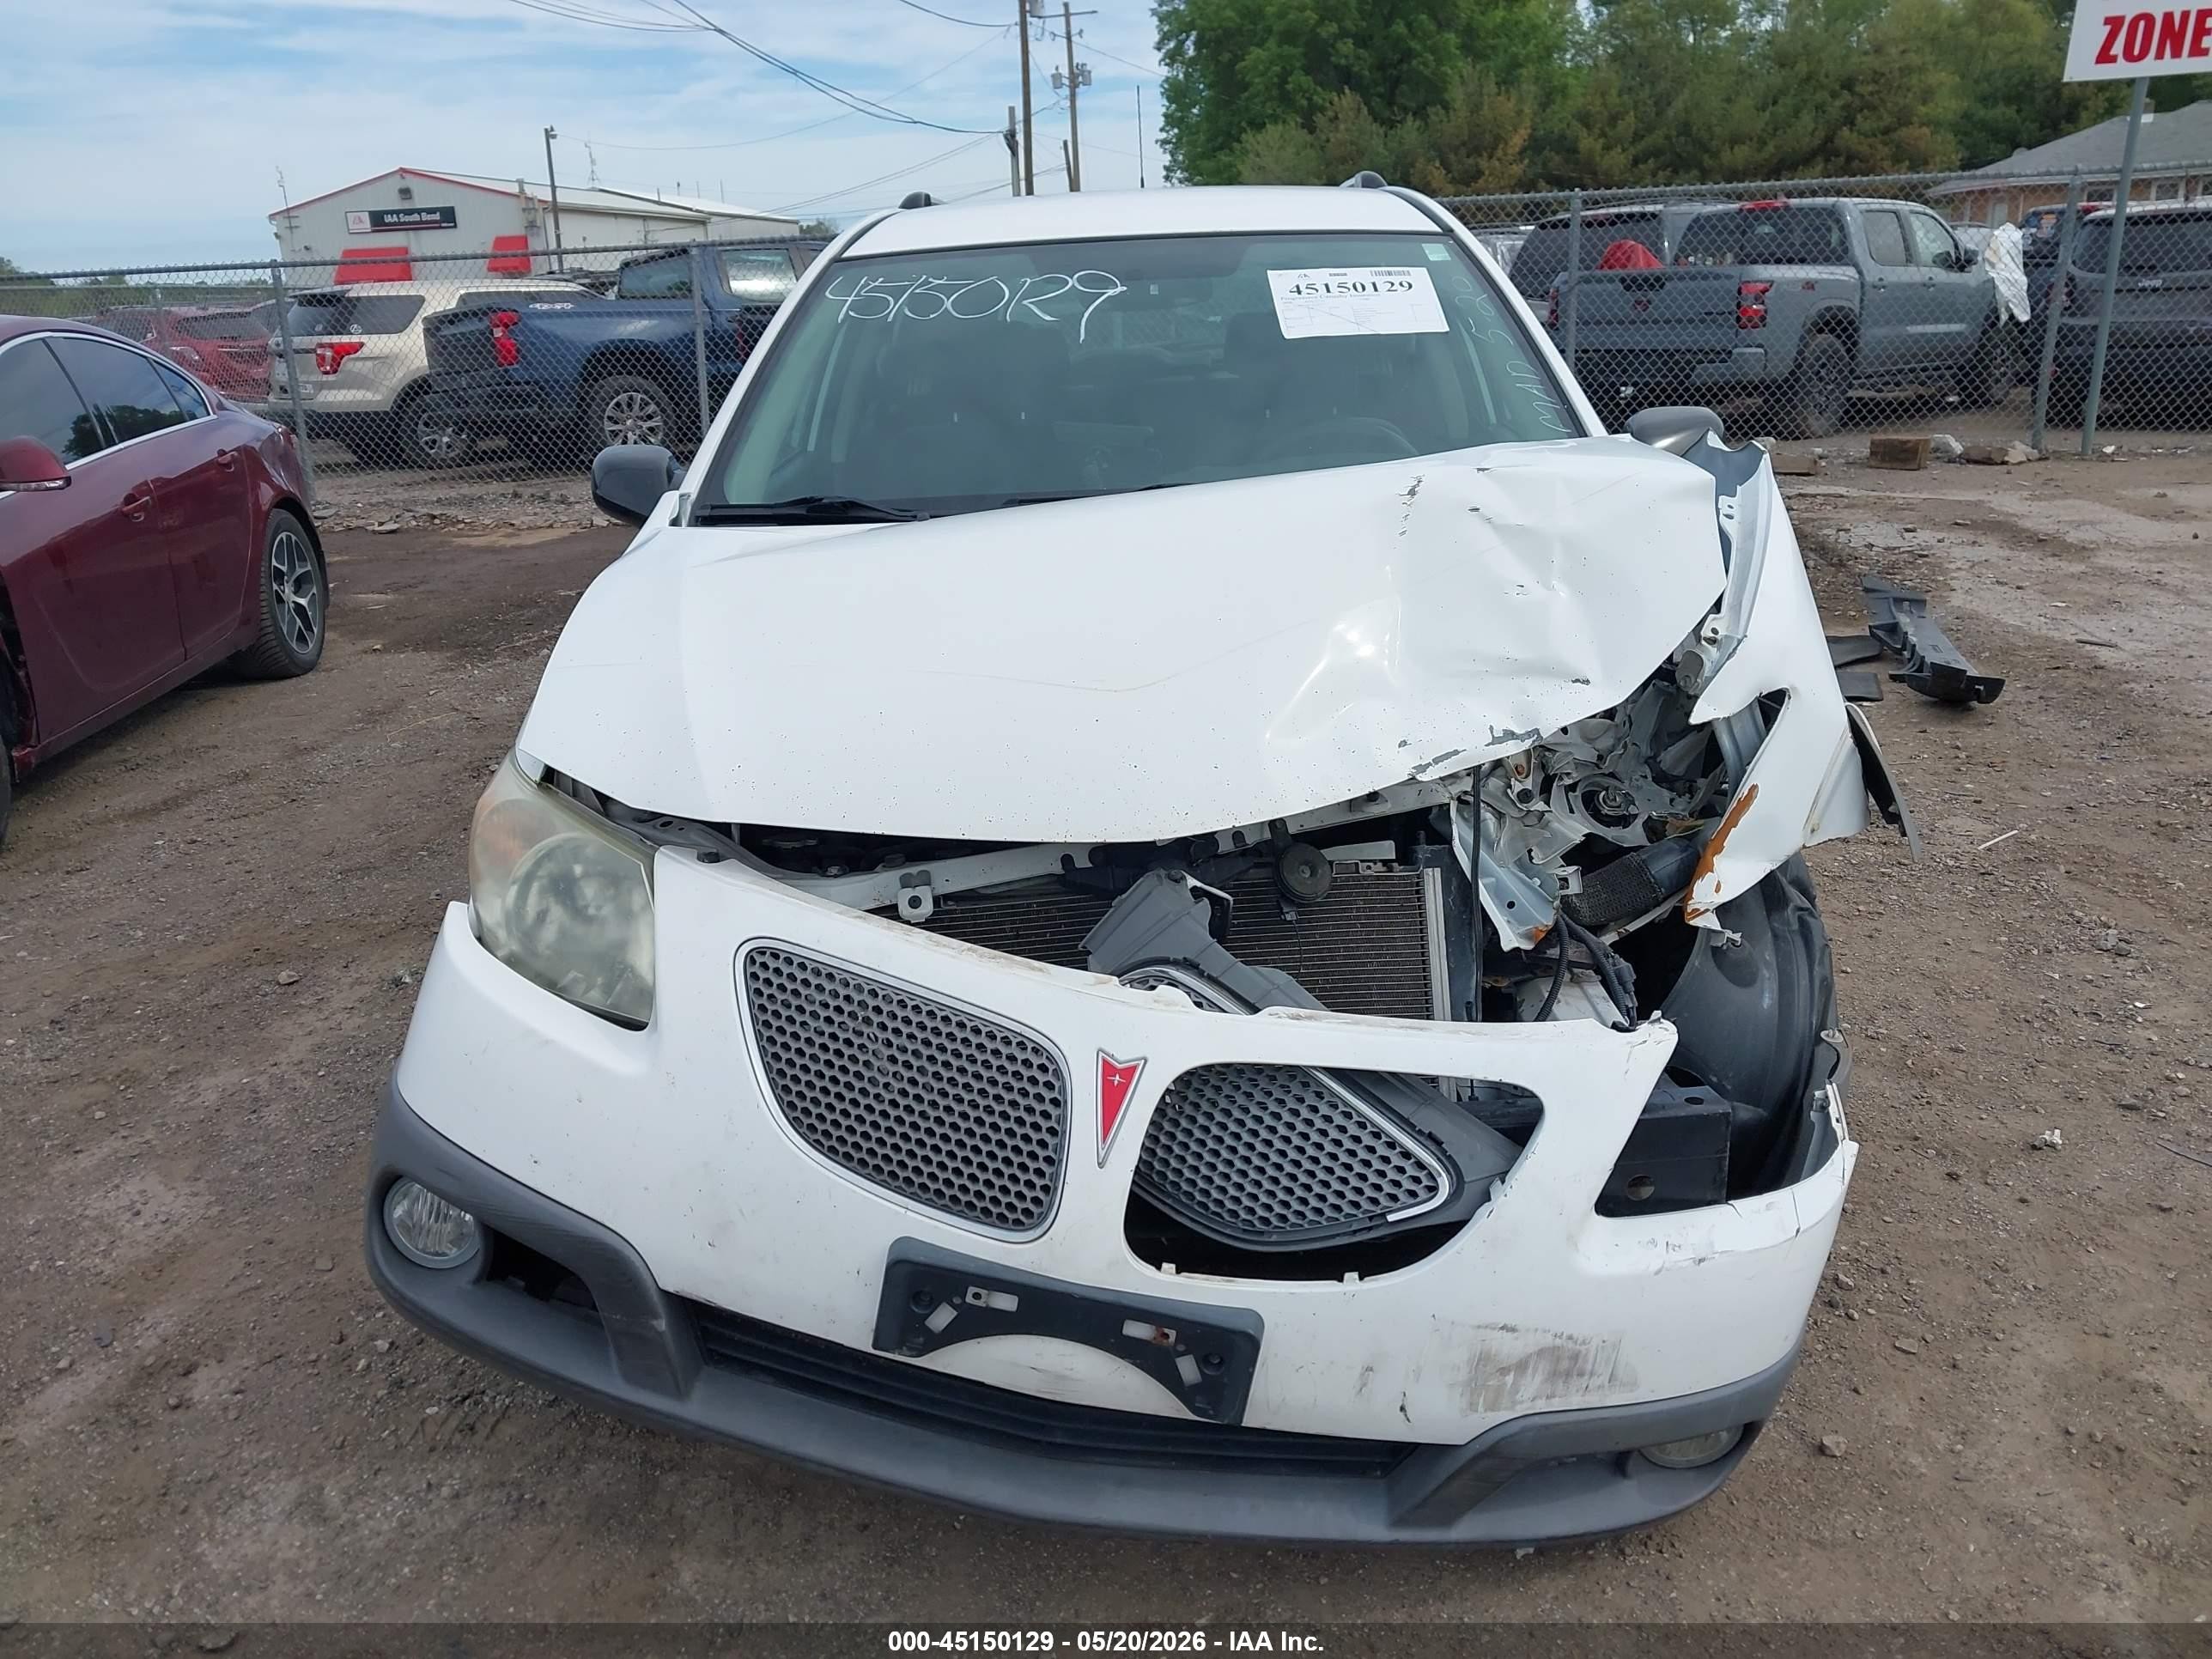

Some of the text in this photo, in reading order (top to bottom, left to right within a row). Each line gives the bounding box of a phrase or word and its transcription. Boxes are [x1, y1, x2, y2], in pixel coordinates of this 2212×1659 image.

[2094, 9, 2212, 64] ZONE
[384, 211, 440, 222] IAA South Bend
[1289, 280, 1413, 295] 45150129
